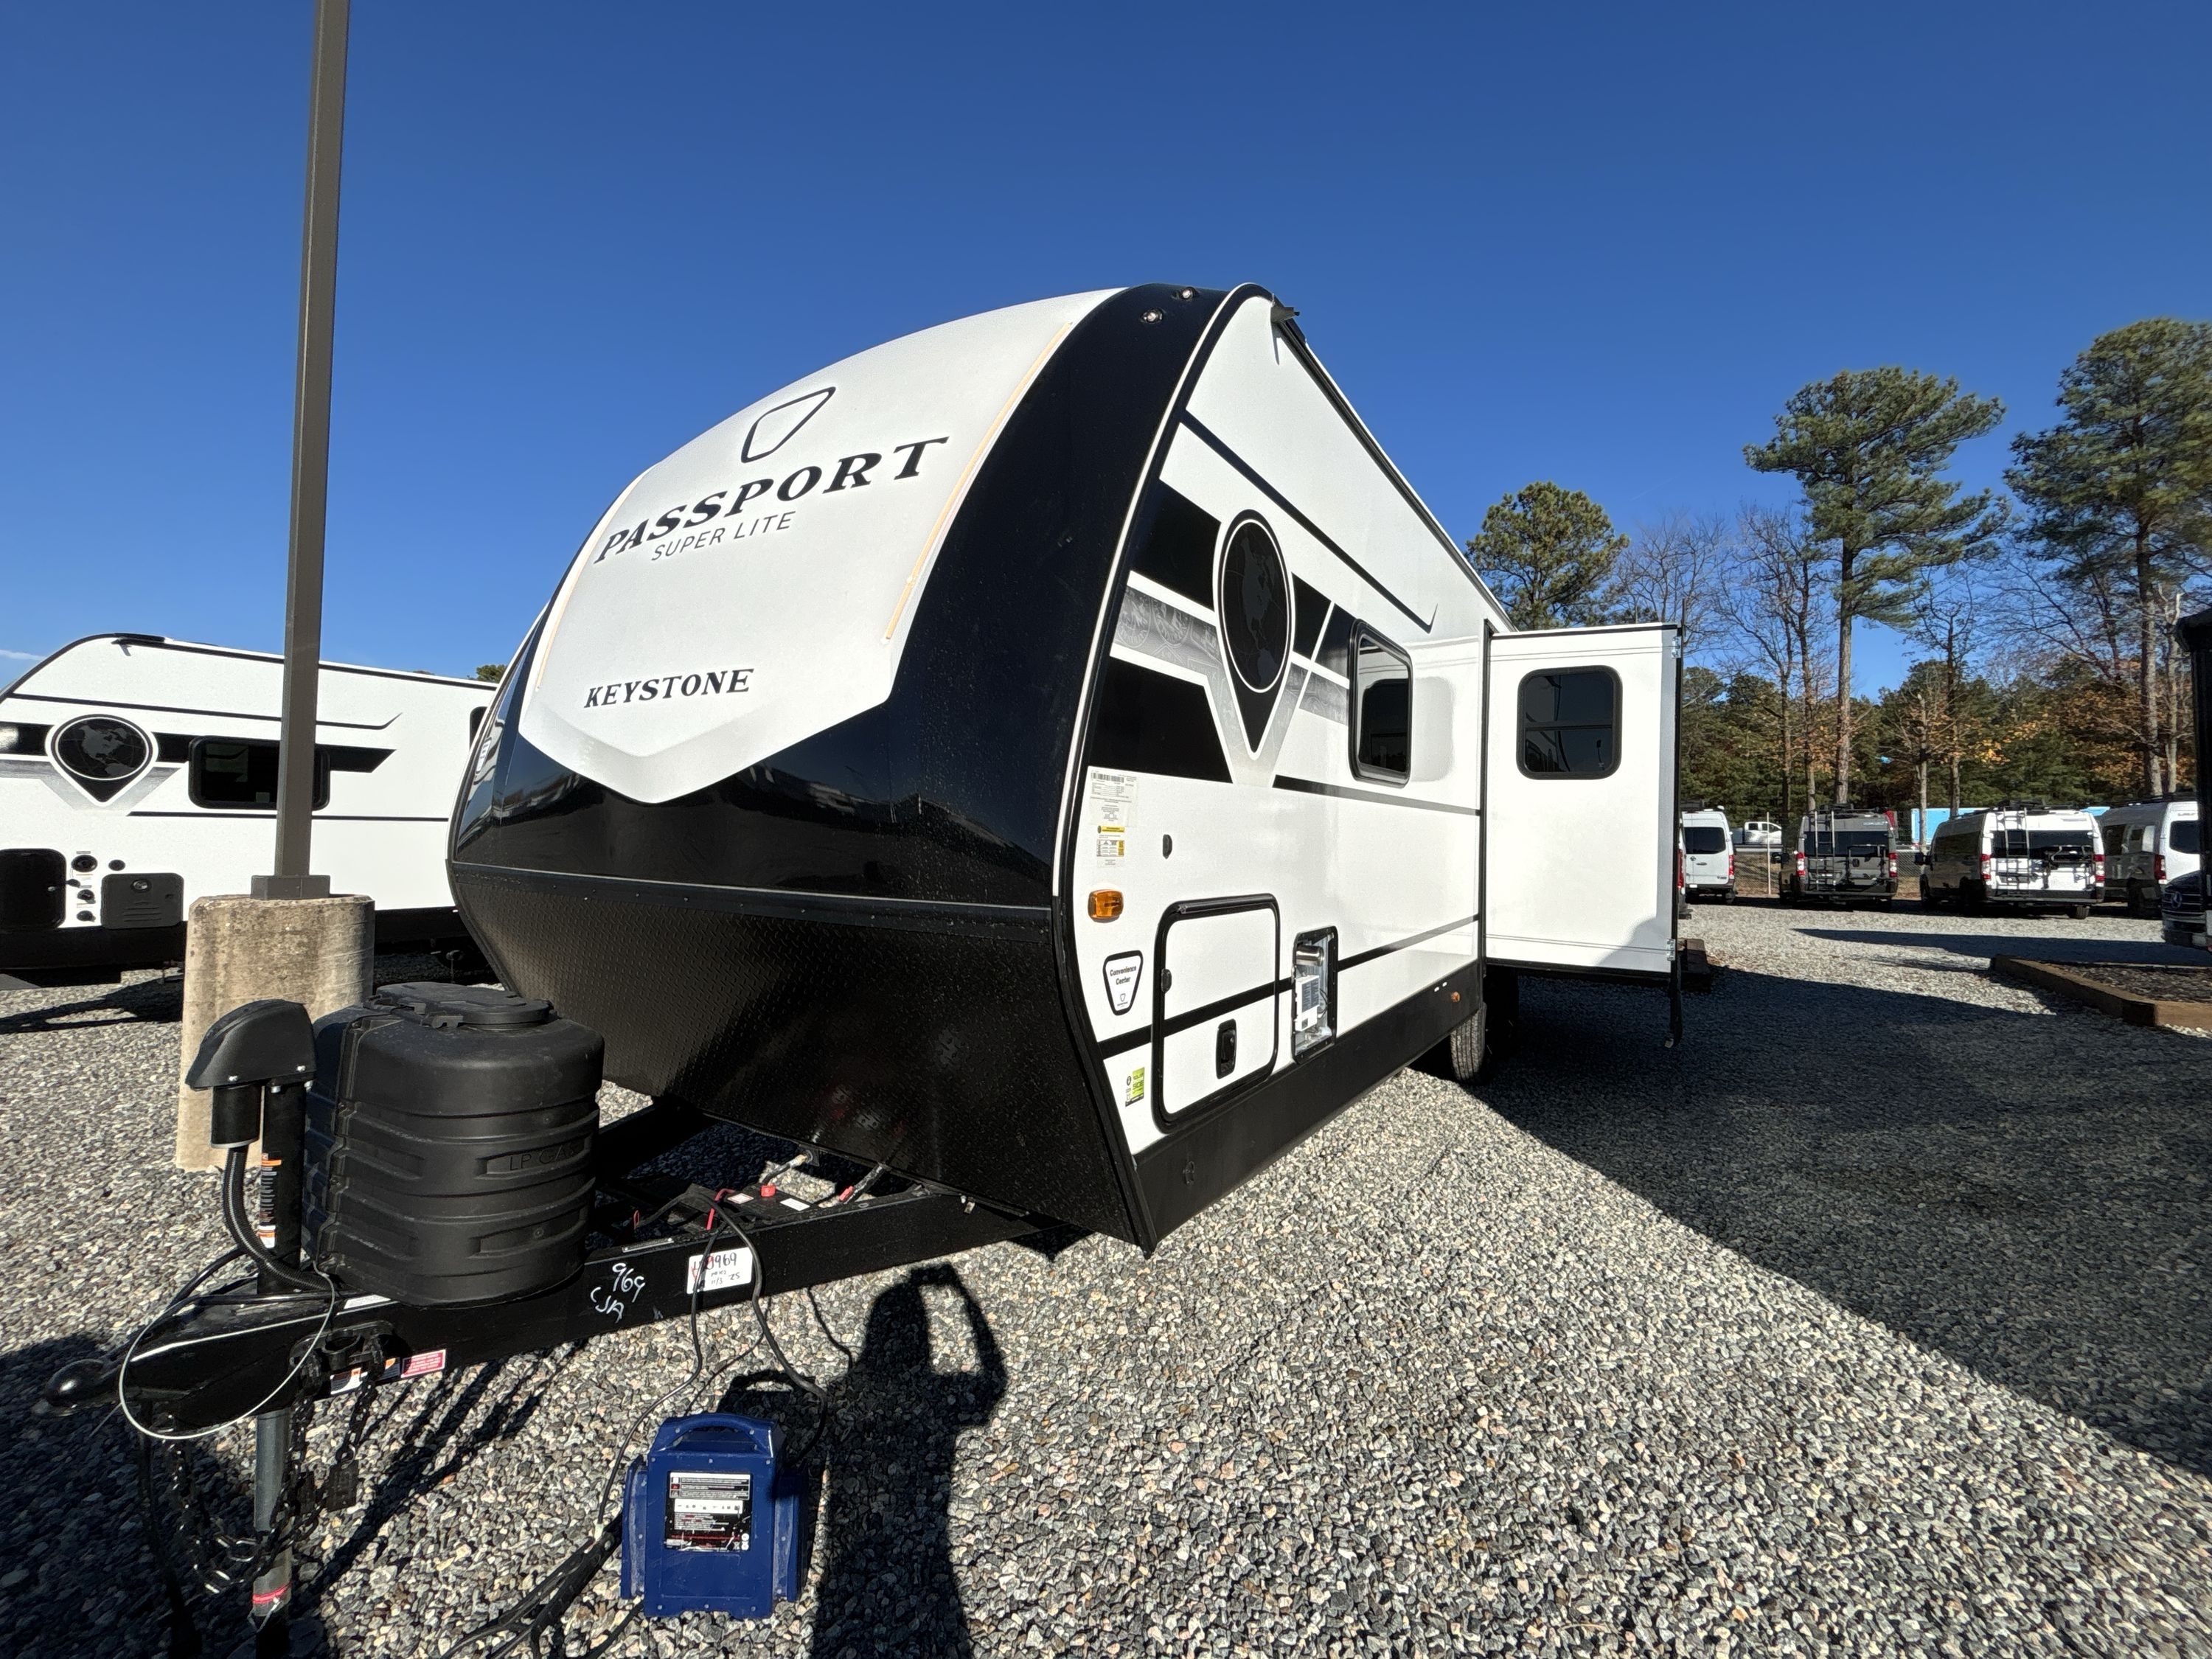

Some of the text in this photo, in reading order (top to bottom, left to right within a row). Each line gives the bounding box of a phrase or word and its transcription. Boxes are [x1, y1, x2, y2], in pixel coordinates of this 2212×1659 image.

[594, 437, 949, 564] PASSPORT
[651, 510, 796, 561] SUPER LITE
[584, 668, 754, 709] KEYSTONE
[1110, 966, 1136, 977] Convenience
[1116, 977, 1131, 985] Center
[509, 1152, 532, 1171] LP
[612, 1262, 646, 1303] 969
